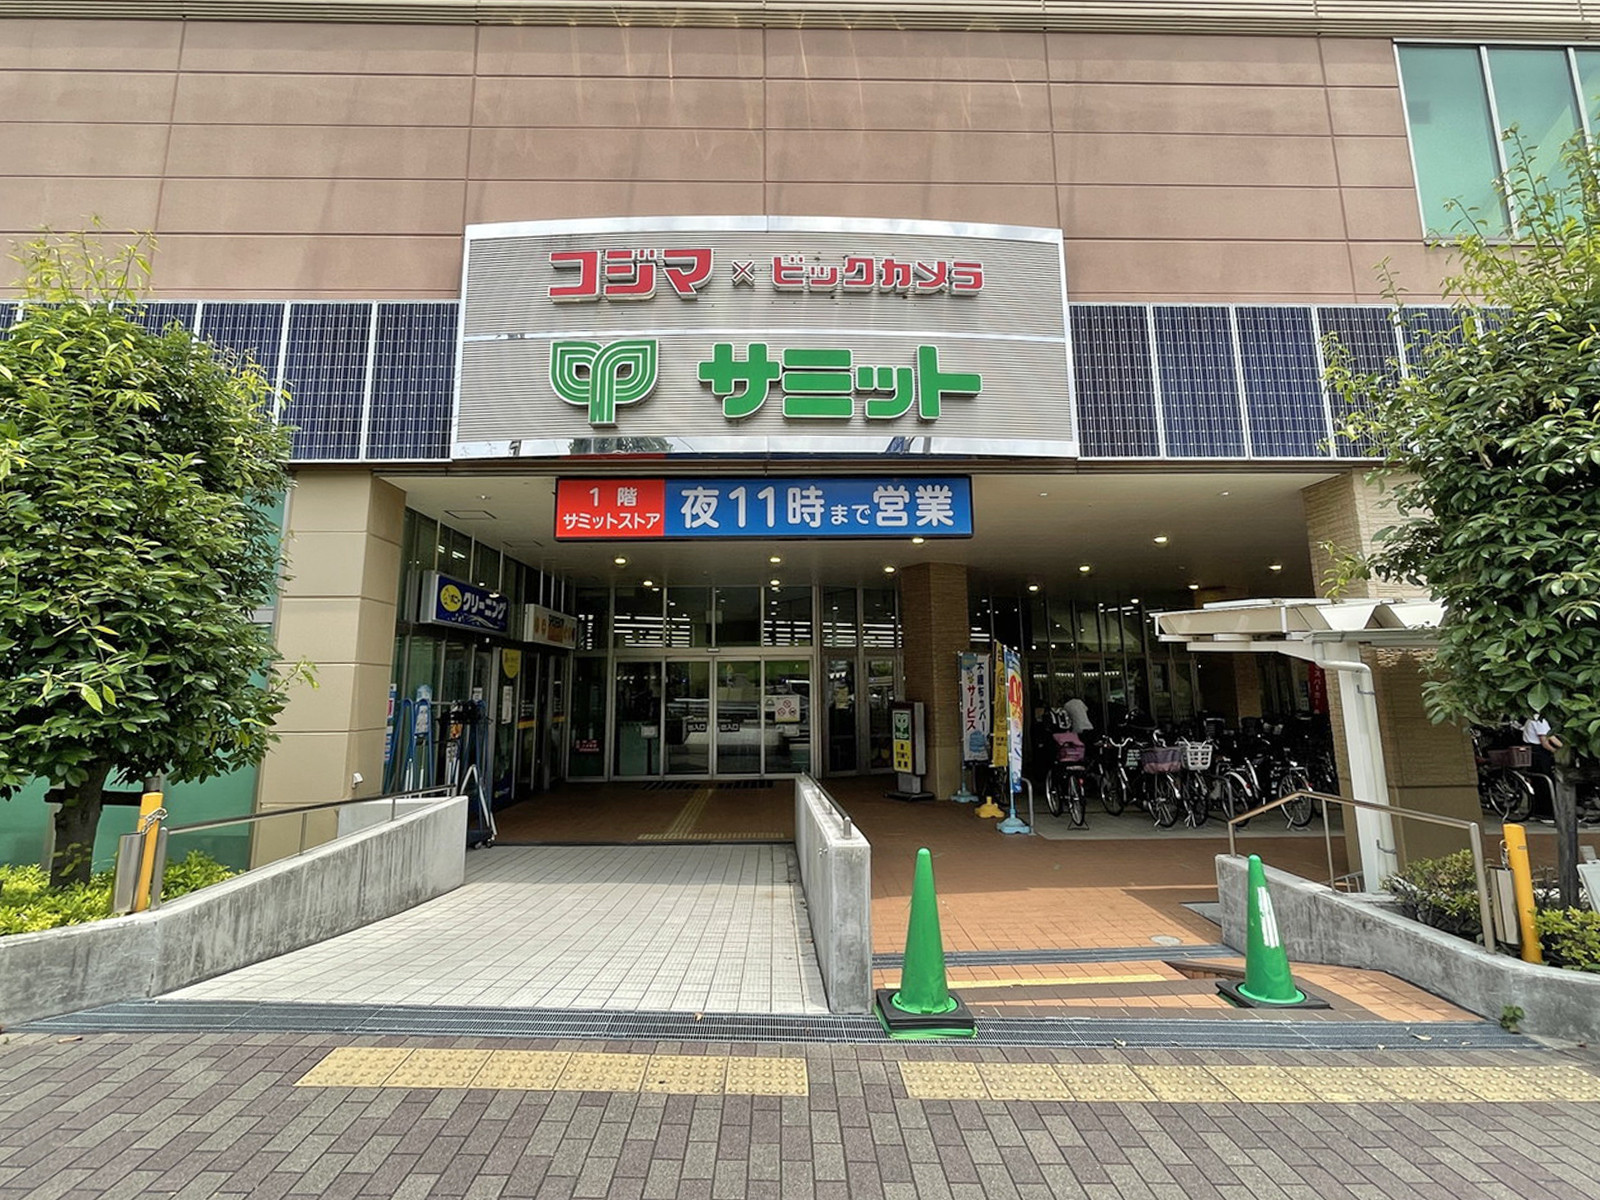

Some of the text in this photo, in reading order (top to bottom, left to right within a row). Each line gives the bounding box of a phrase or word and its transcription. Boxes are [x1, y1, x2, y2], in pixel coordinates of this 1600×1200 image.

[548, 248, 713, 301] コジマ
[772, 256, 984, 295] ビックカメラ
[697, 342, 983, 420] サミット
[563, 512, 661, 530] サミットストア
[680, 485, 955, 529] 夜11時まで営業
[463, 592, 507, 620] クリーニング
[966, 685, 977, 731] サービス
